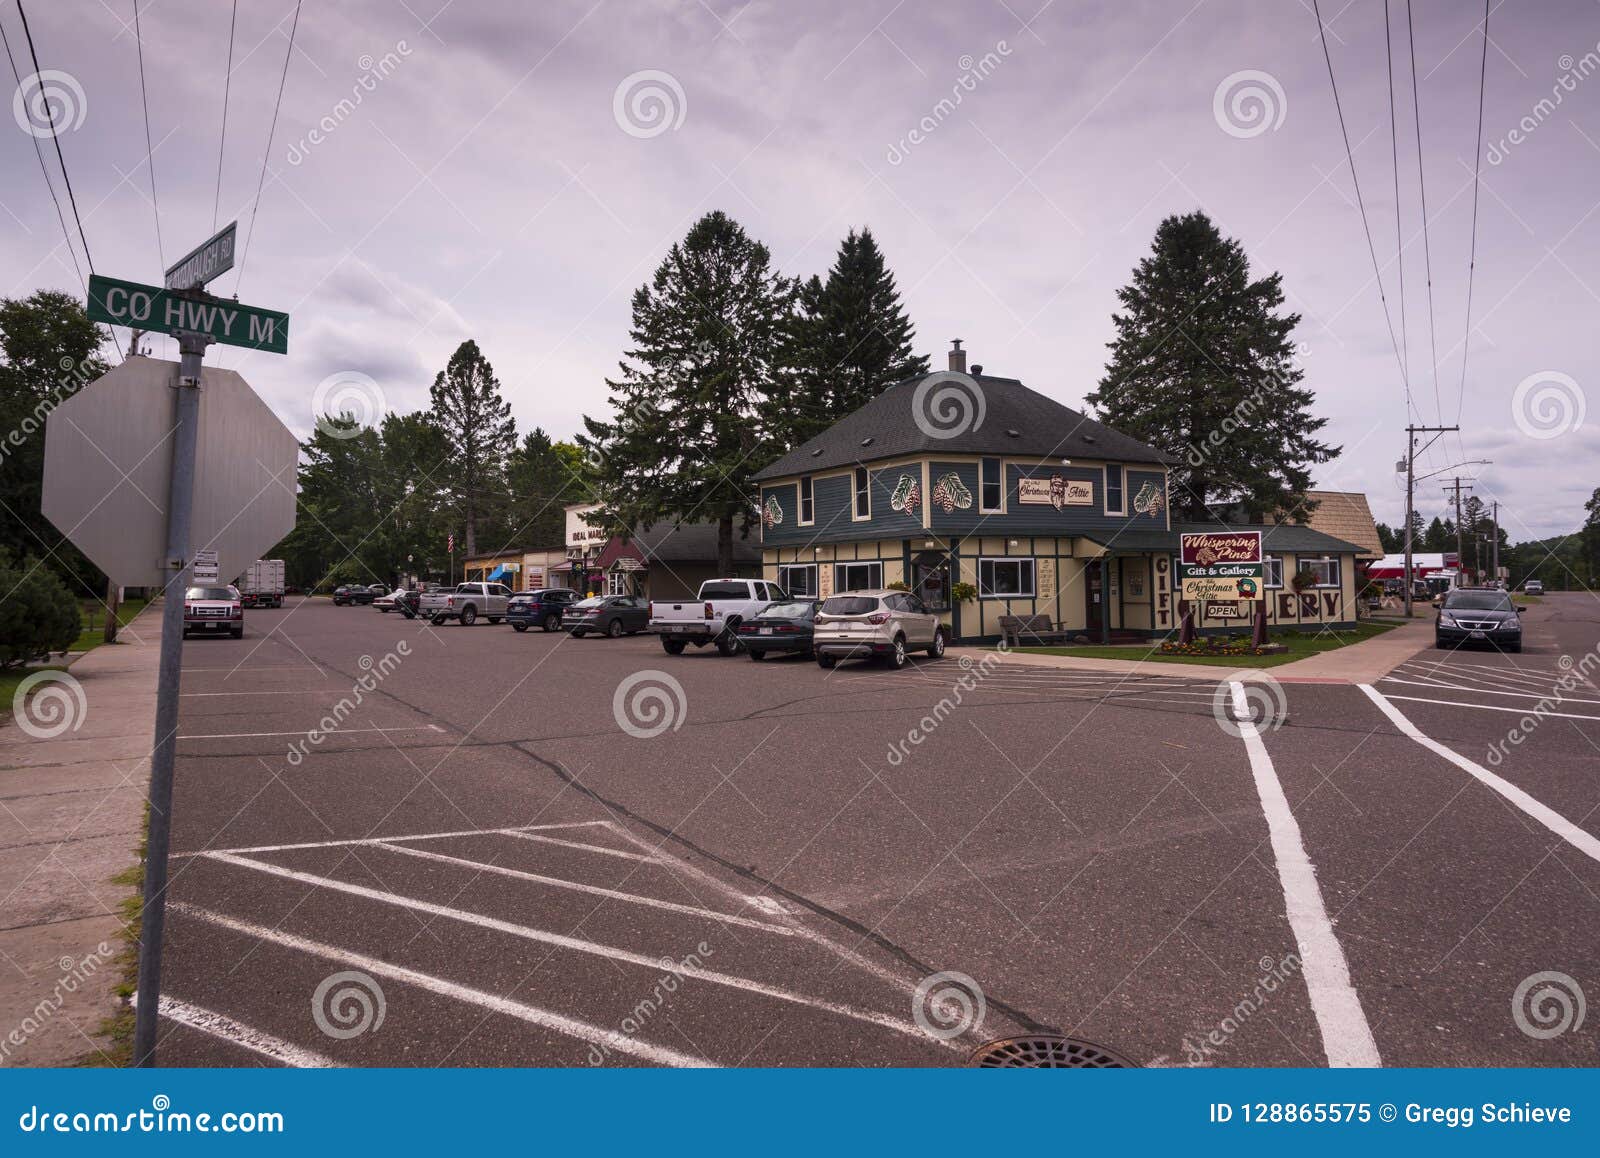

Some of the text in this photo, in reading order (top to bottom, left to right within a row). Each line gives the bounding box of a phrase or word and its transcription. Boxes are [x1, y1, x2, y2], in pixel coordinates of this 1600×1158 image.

[220, 236, 232, 262] RD
[106, 287, 275, 344] CO HWY M
[1068, 486, 1090, 498] Attic
[1183, 535, 1257, 550] Whispering
[1215, 547, 1253, 560] Pines
[1187, 566, 1256, 577] Gift & Gallery
[1156, 558, 1170, 625] GIFT
[1186, 580, 1233, 594] Christmas
[1194, 591, 1218, 600] Attic
[1208, 606, 1238, 616] OPEN
